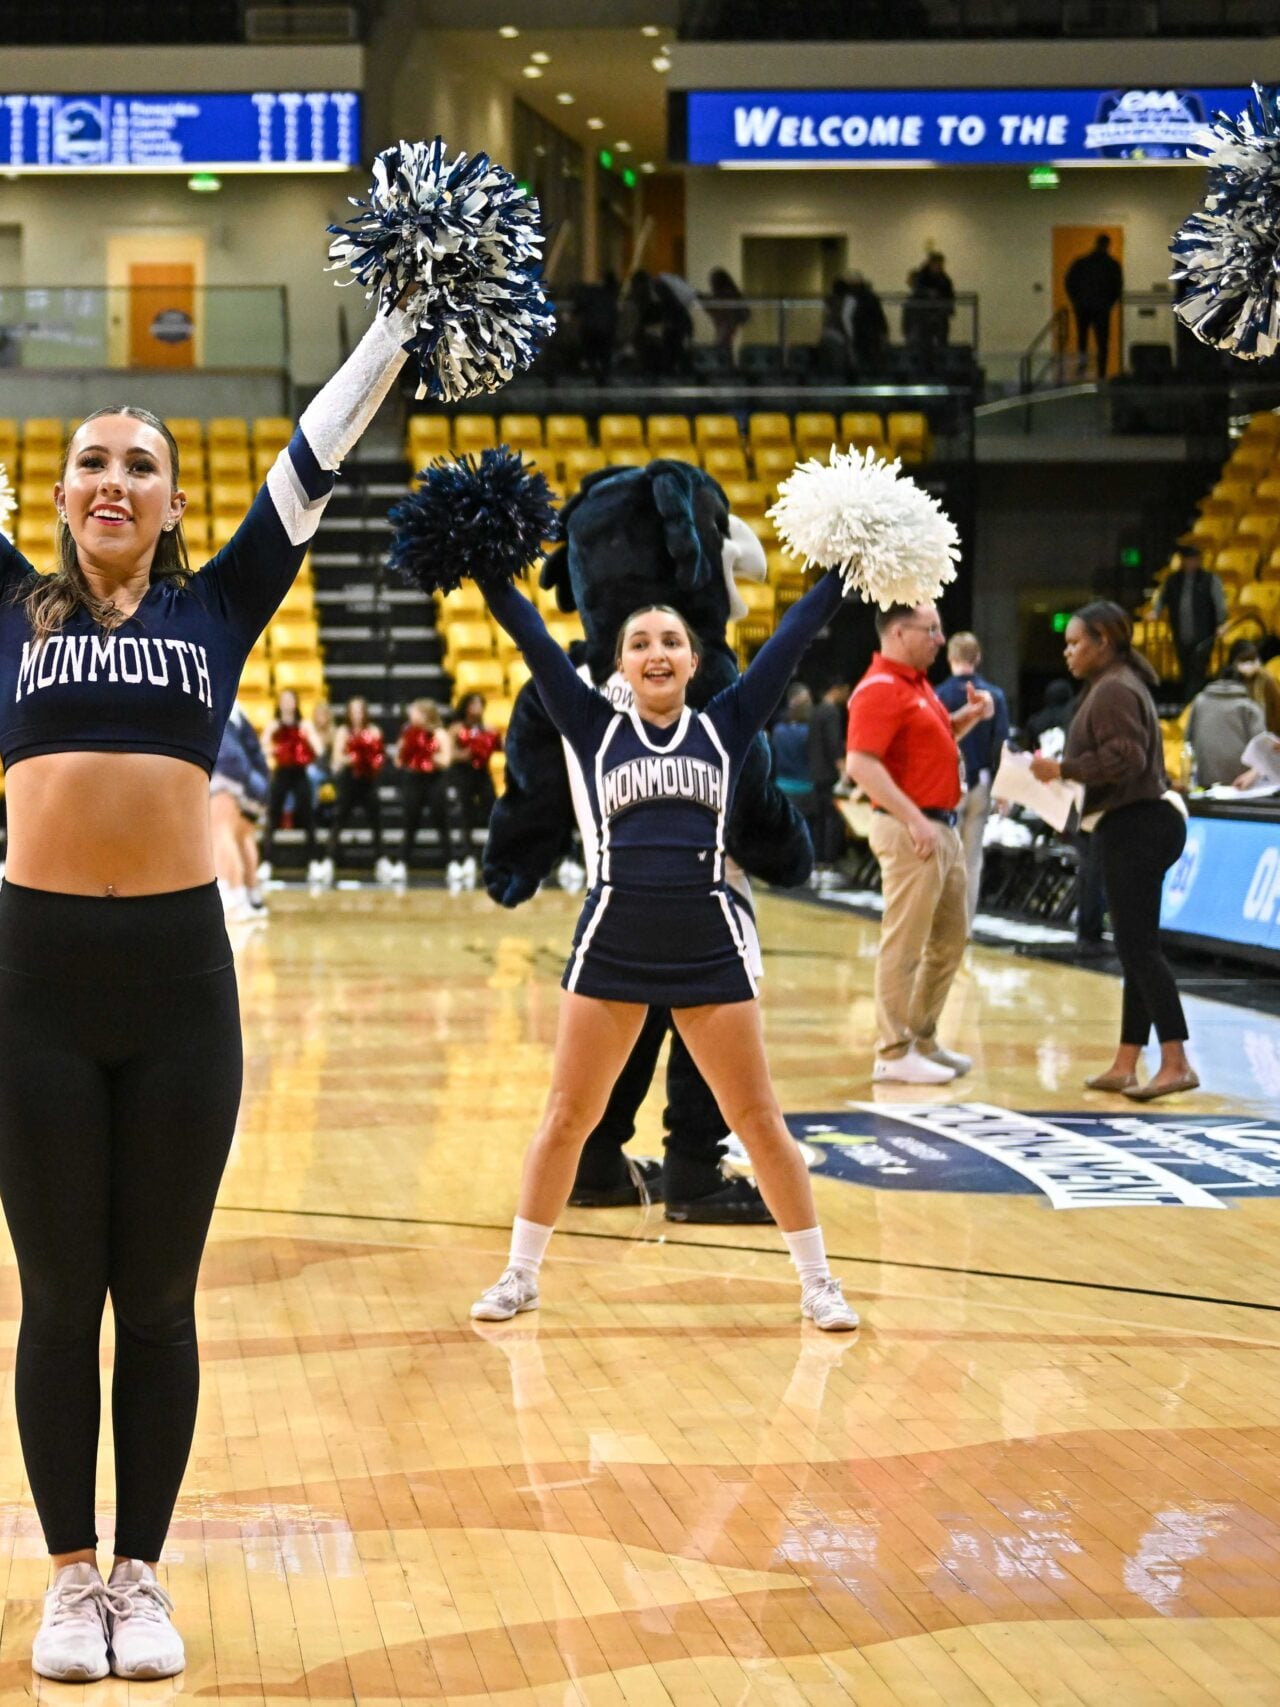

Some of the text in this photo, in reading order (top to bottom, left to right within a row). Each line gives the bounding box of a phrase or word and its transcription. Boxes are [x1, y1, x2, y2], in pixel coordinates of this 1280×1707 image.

[937, 116, 986, 146] TO
[1000, 115, 1068, 145] THE
[15, 635, 213, 709] MONMOUTH
[601, 755, 722, 818] MONMOUTH
